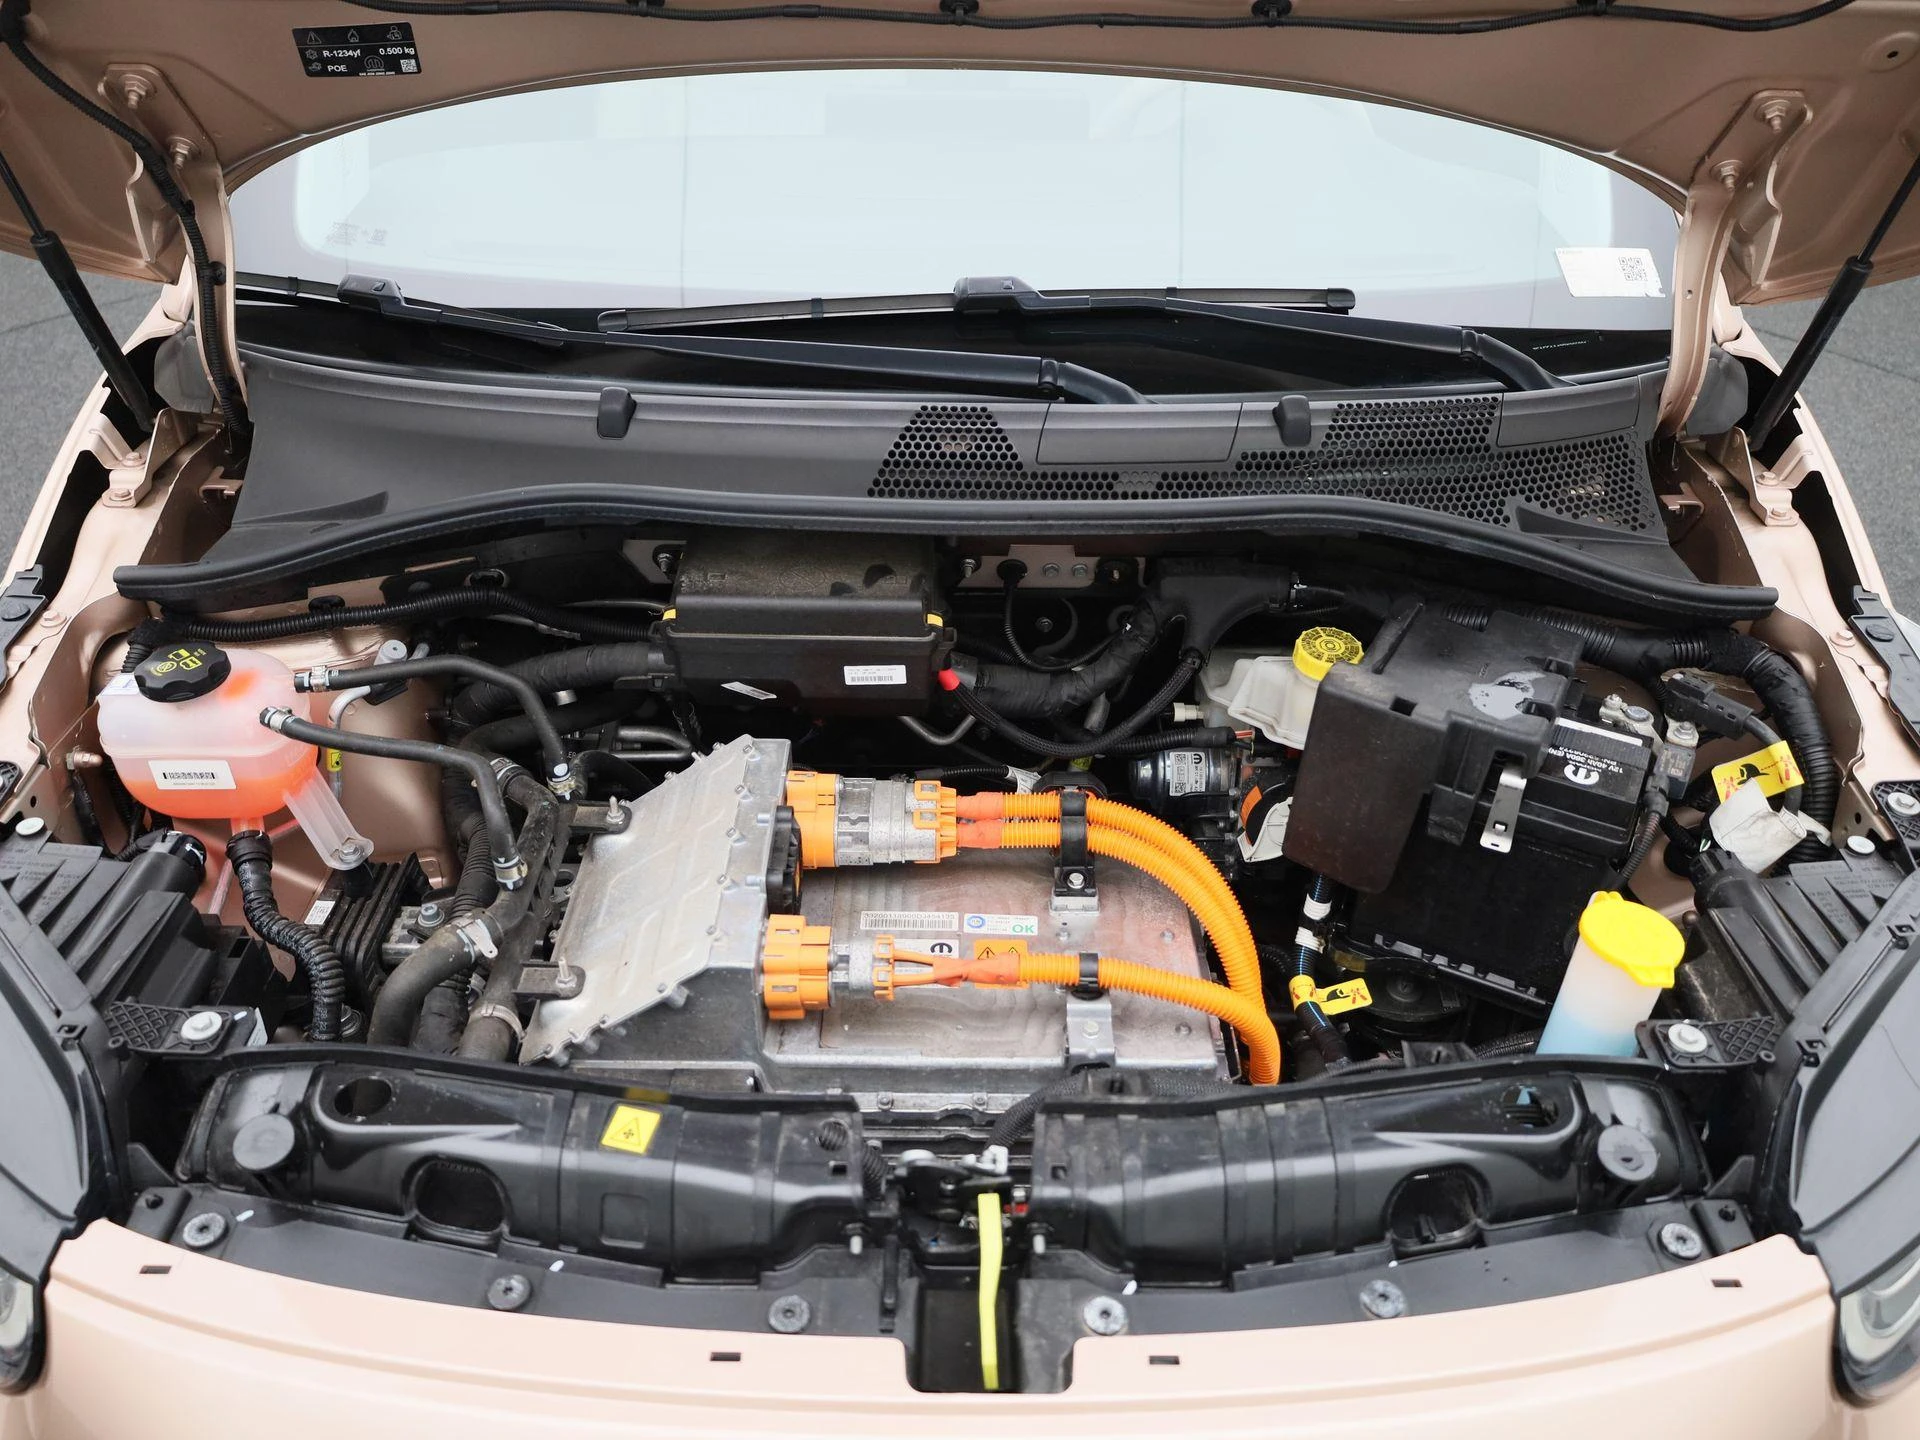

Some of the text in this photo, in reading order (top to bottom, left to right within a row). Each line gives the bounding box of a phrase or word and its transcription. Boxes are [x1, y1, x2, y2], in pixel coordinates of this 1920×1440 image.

[322, 49, 360, 58] R-1234yf
[379, 46, 415, 55] 0.500 kg
[327, 64, 348, 72] POE
[1609, 764, 1623, 774] 12V
[1011, 923, 1035, 935] OK
